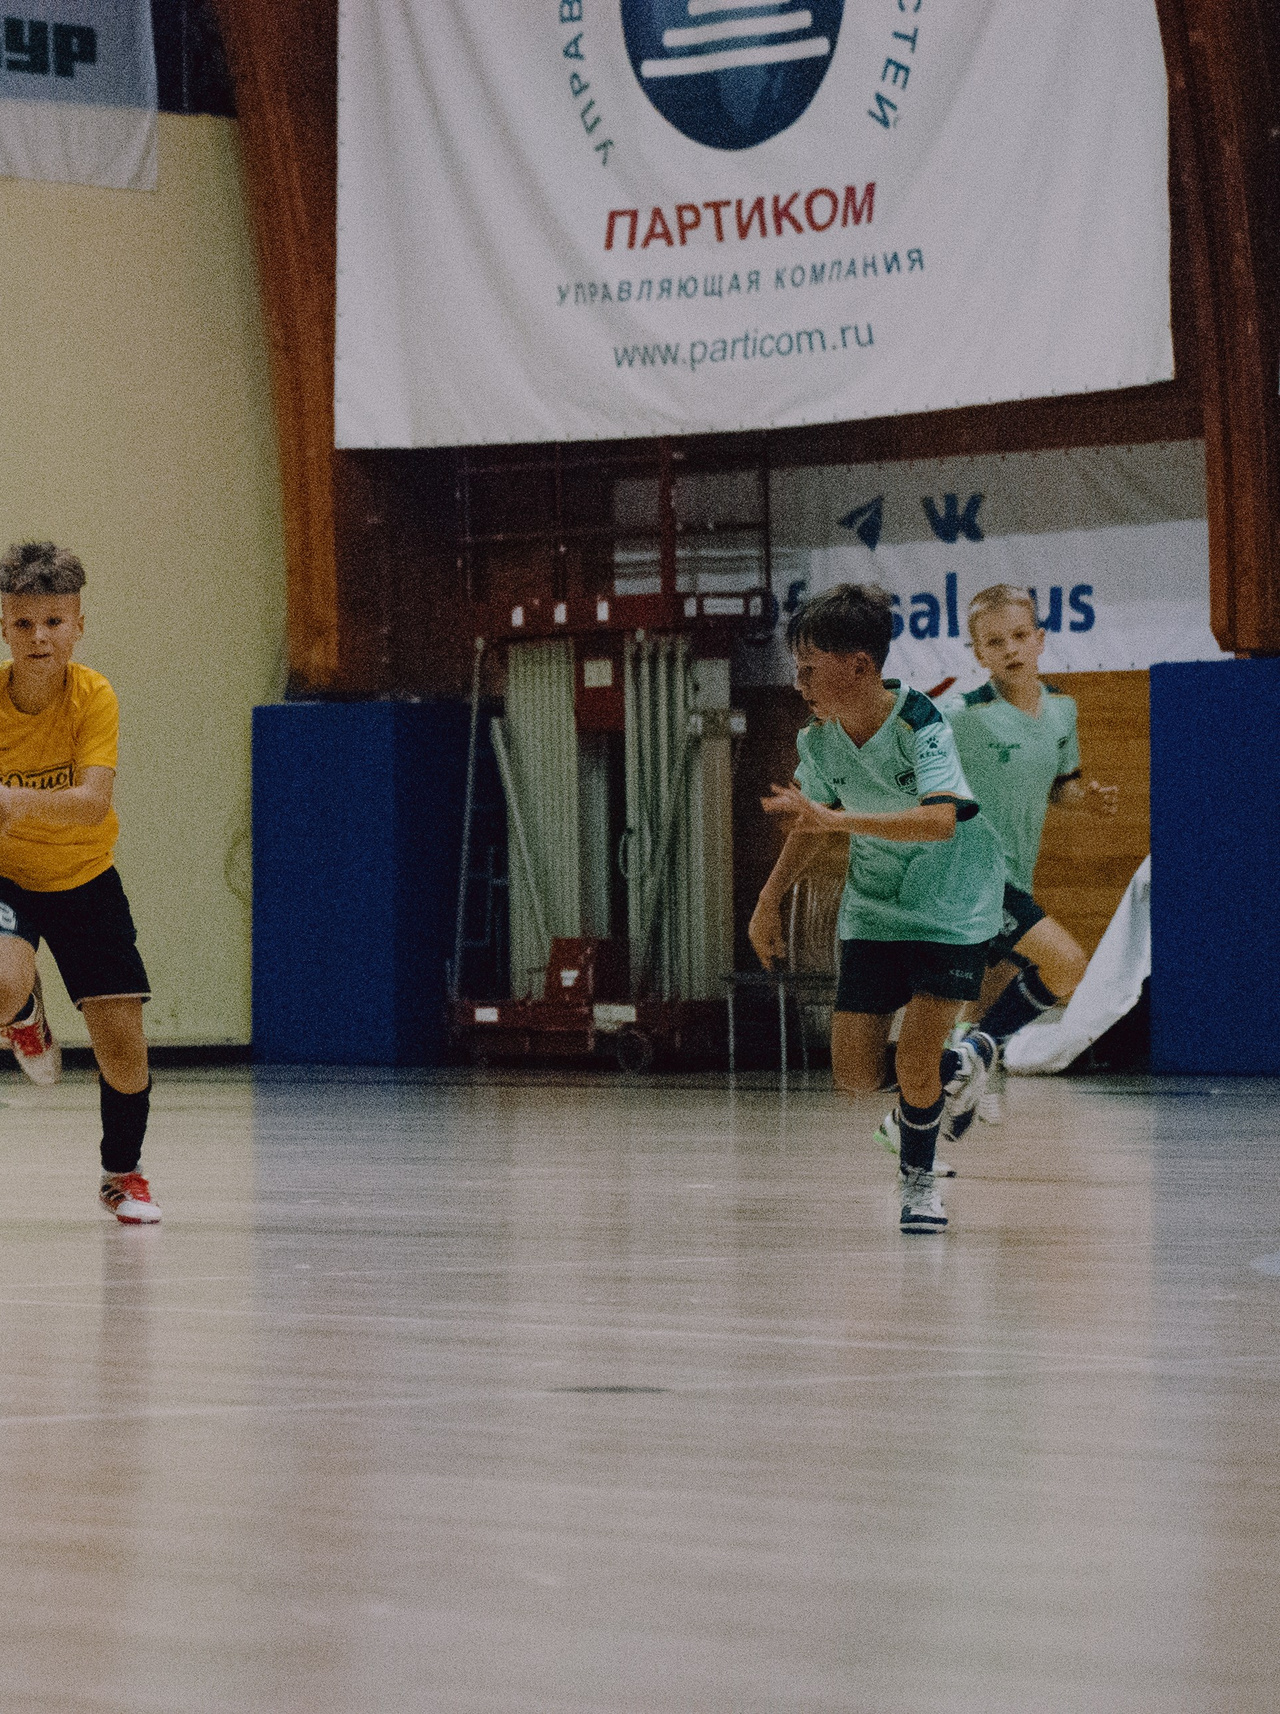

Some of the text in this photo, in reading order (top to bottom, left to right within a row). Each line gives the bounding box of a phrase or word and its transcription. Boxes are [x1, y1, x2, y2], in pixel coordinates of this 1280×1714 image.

[604, 182, 876, 251] ПАРТИКОМ
[556, 247, 925, 307] УПРАВЛЯЮЩАЯ КОМПАНИЯ
[613, 322, 876, 372] www.particom.ru
[922, 492, 985, 544] VK
